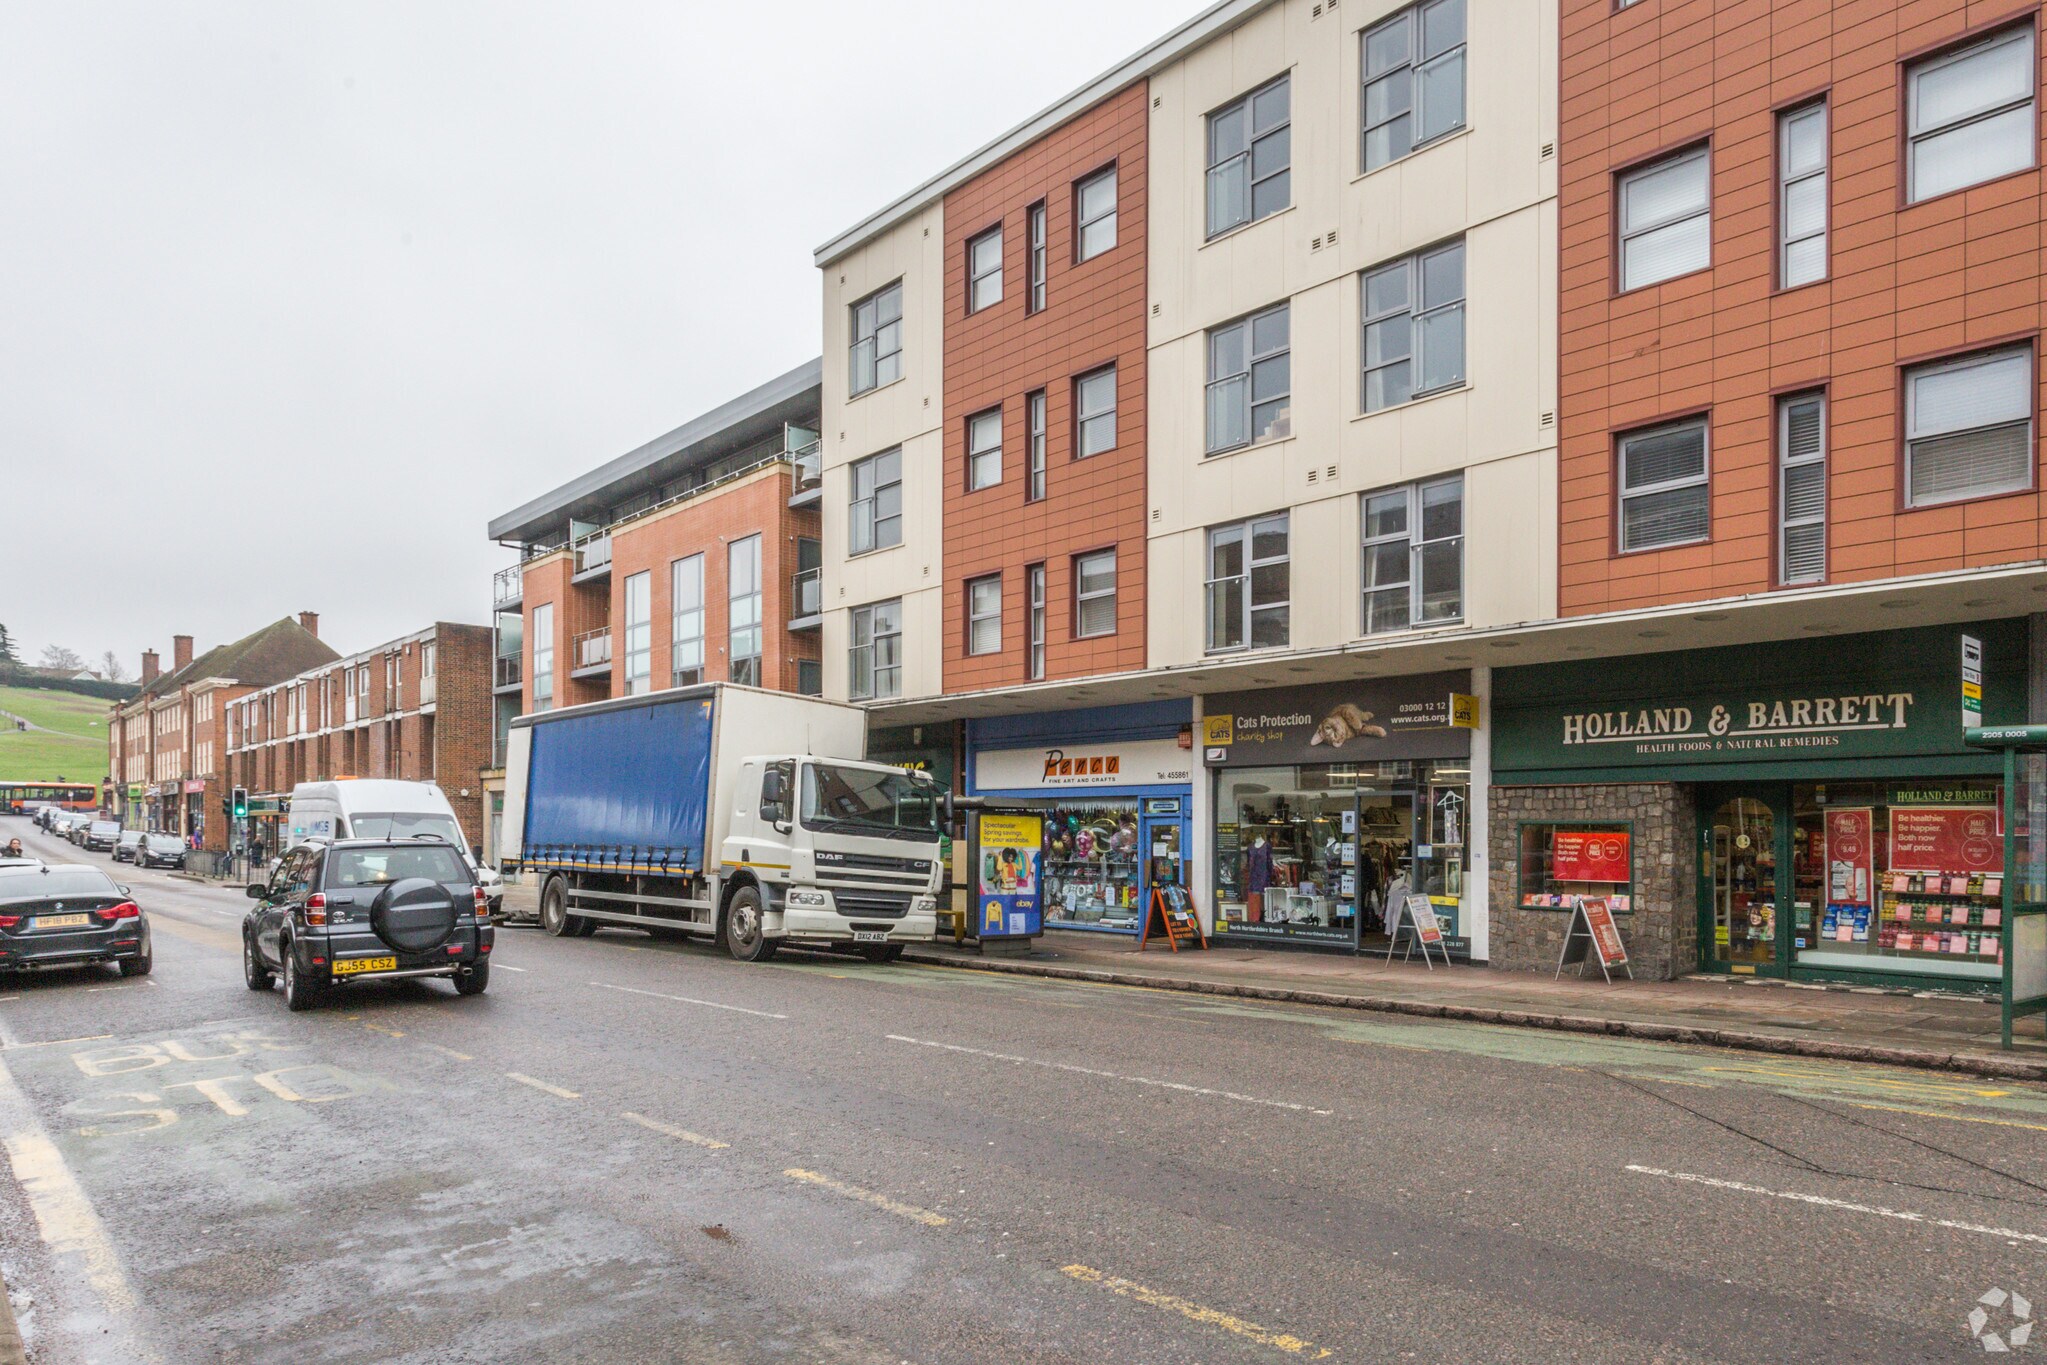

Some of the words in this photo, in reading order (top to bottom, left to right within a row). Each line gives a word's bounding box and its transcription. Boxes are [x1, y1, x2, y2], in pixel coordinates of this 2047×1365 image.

[1399, 704, 1423, 712] 03000
[1425, 702, 1434, 711] 12
[1436, 701, 1446, 710] 12
[1454, 711, 1471, 720] CATS
[1562, 707, 1692, 744] HOLLAND
[1708, 704, 1731, 736] &
[1747, 693, 1913, 728] BARRETT
[1236, 716, 1258, 729] Cats
[1260, 713, 1312, 727] Protection
[1210, 729, 1230, 739] CATS
[1236, 730, 1265, 744] charity
[2005, 730, 2027, 738] 0005
[1636, 743, 1675, 753] HEALTH
[1678, 741, 1712, 752] FOODS
[1715, 741, 1723, 750] &
[1727, 738, 1776, 750] NATURAL
[1780, 736, 1839, 747] REMEDIES
[1042, 749, 1117, 783] Penco
[1167, 771, 1189, 779] 455861
[1896, 790, 1942, 802] HOLLAND
[1943, 790, 1953, 801] &
[1955, 790, 1997, 800] BARRET
[1898, 814, 1909, 822] Be
[1910, 814, 1946, 822] healthier.
[983, 822, 1016, 830] Spectacular
[1840, 826, 1856, 834] PRICE
[1898, 824, 1909, 832] Be
[1910, 824, 1942, 833] happier.
[1969, 828, 1986, 836] PRICE
[1897, 843, 1912, 851] half
[1913, 844, 1936, 853] price.
[1016, 900, 1033, 909] ebay
[336, 961, 366, 972] GJ55
[371, 958, 393, 969] CSZ
